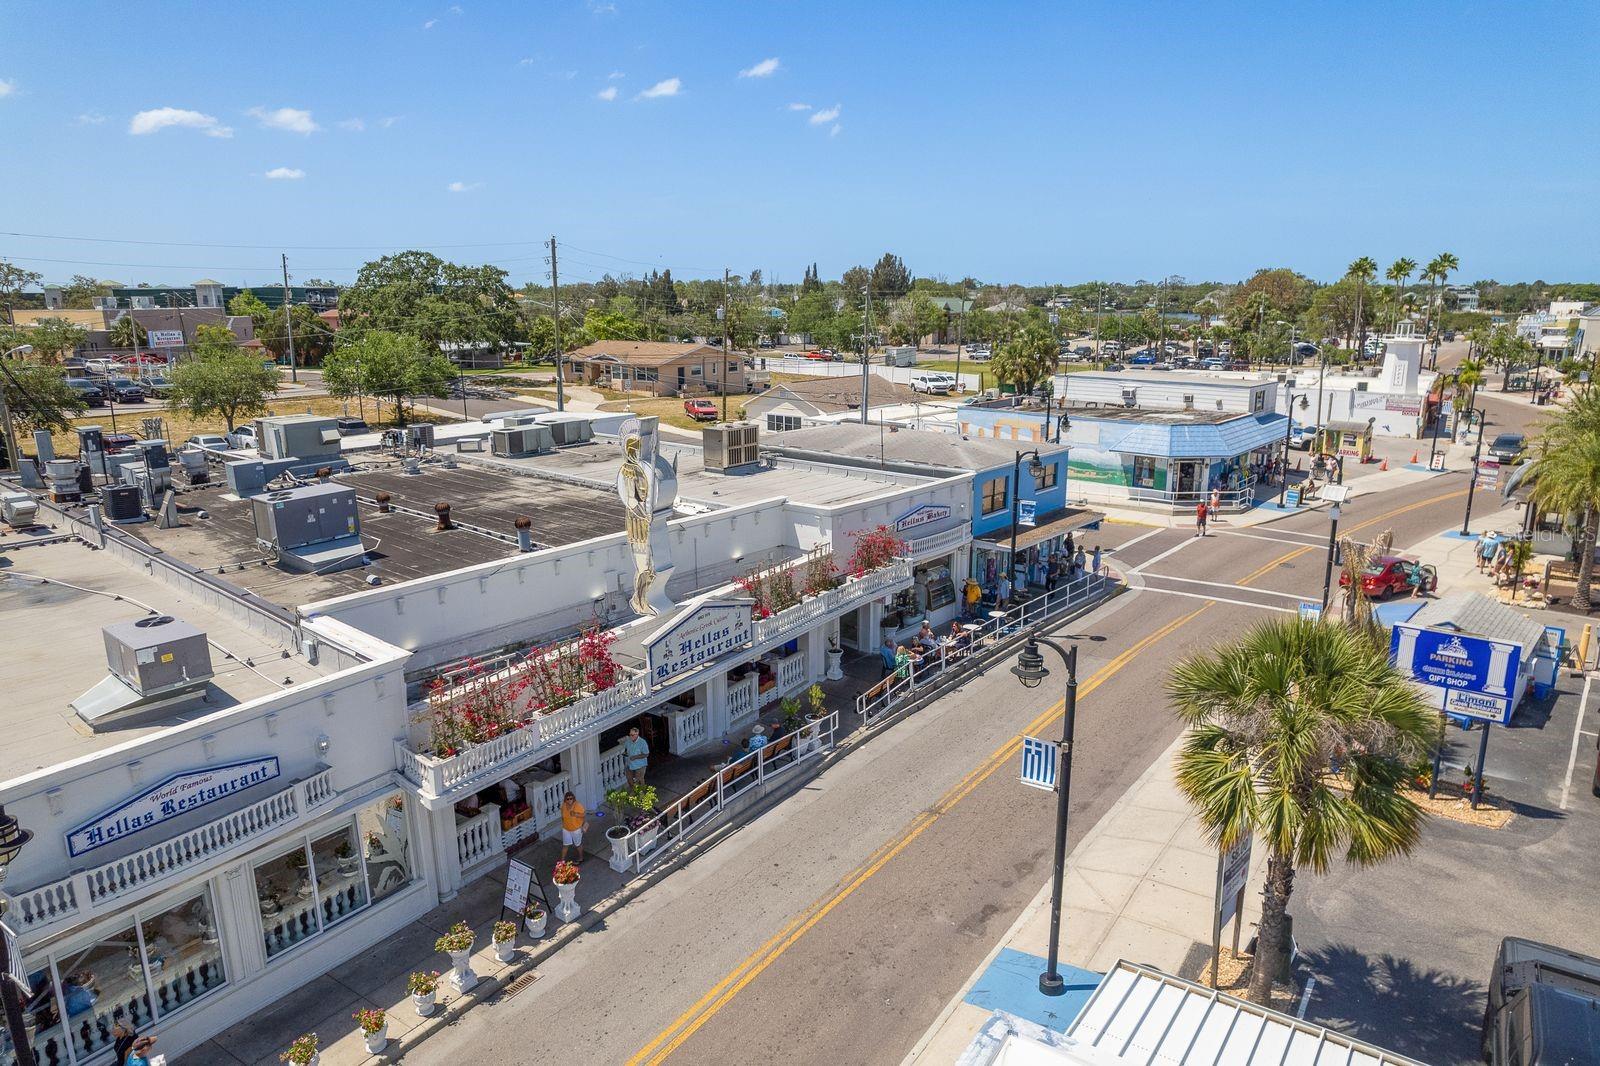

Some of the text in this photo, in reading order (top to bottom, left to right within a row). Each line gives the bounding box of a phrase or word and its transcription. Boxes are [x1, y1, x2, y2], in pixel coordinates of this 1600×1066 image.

[1338, 449, 1360, 457] ARKING
[656, 629, 749, 679] Restaurant
[679, 626, 730, 657] Hellas
[1430, 653, 1474, 667] PARKING
[1428, 674, 1469, 687] GIFT SHOP
[149, 774, 213, 803] World Famous
[85, 765, 268, 847] Hellas Restaurant
